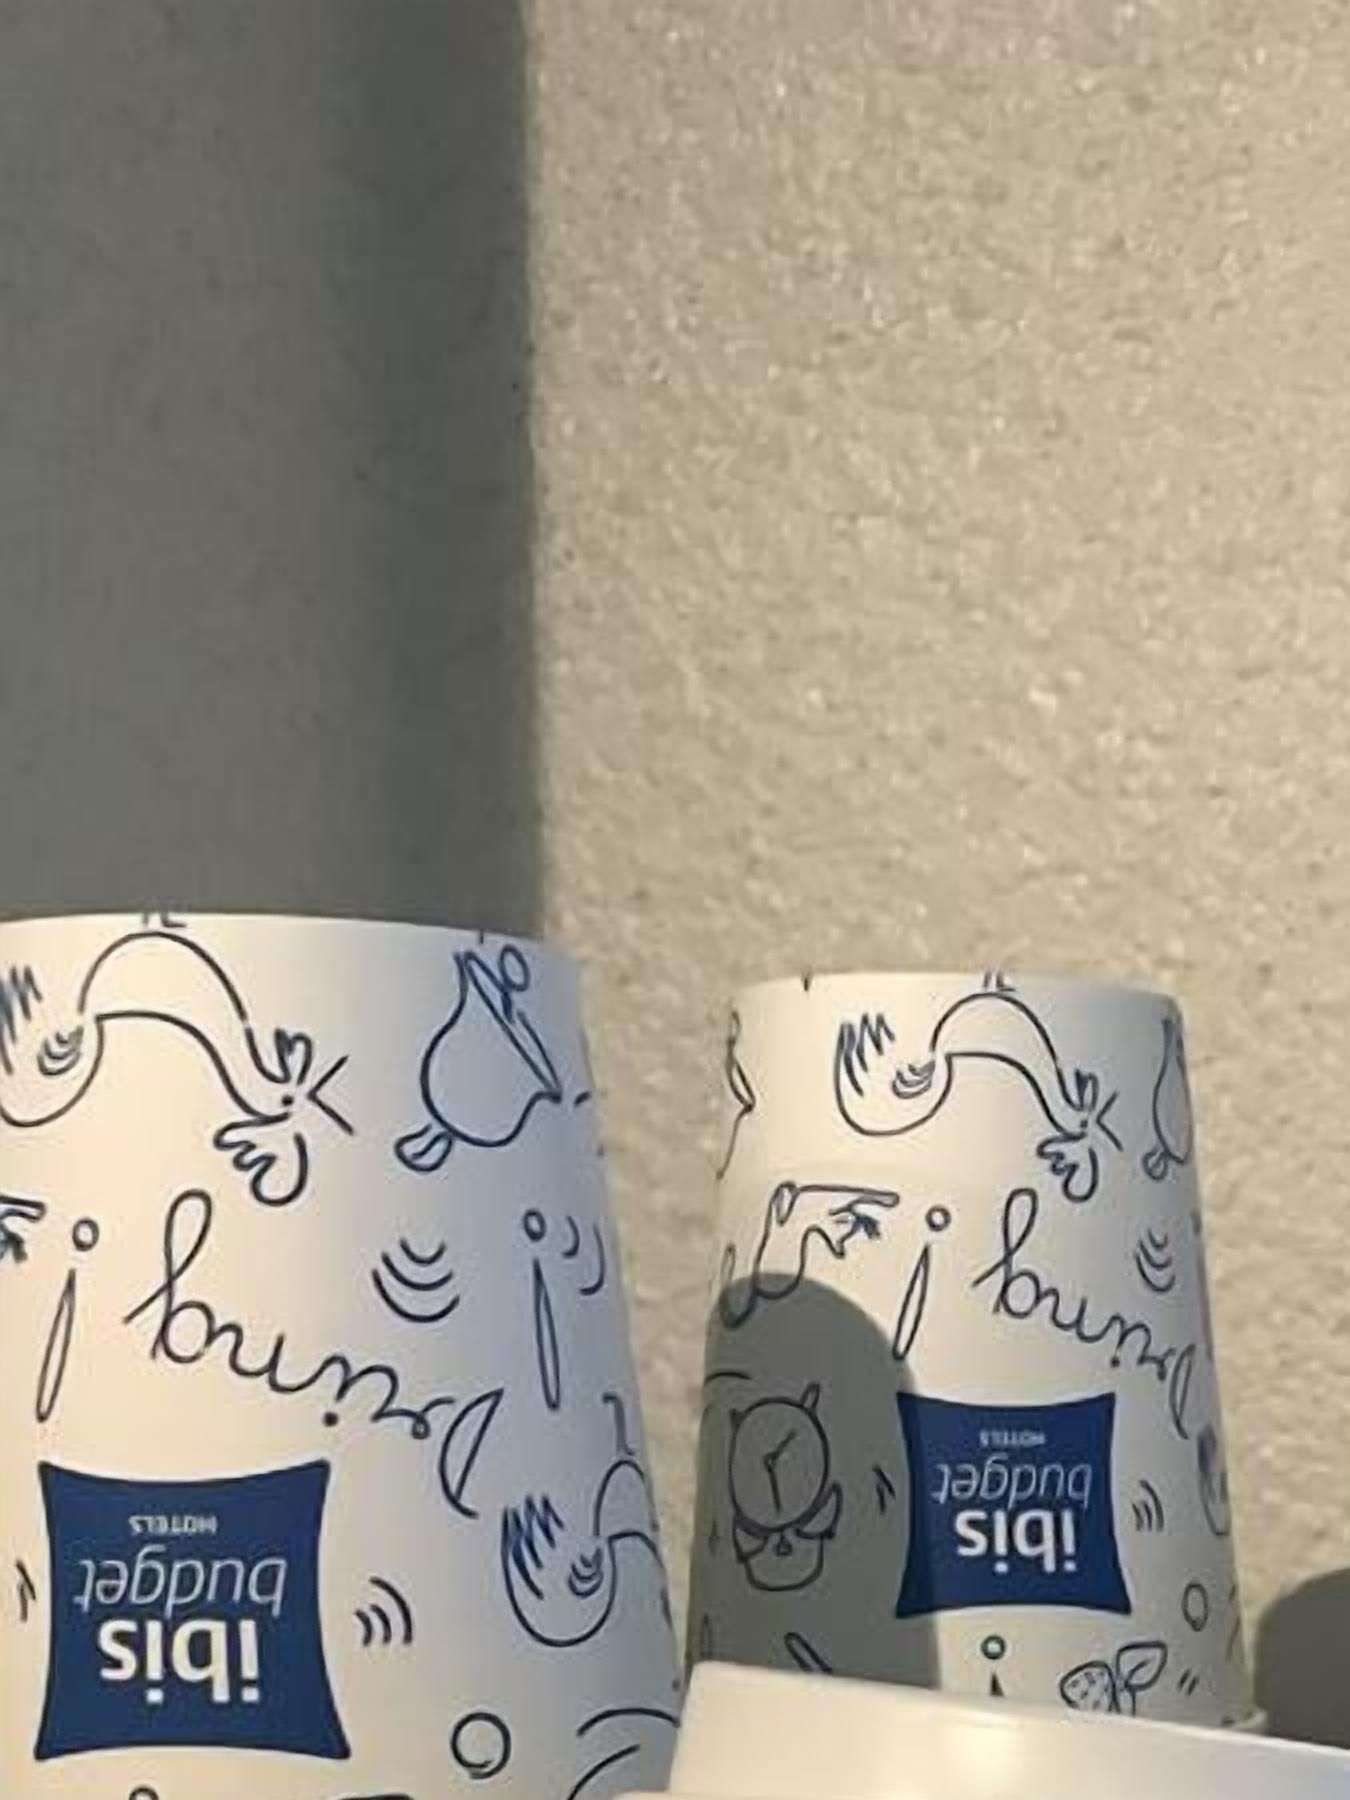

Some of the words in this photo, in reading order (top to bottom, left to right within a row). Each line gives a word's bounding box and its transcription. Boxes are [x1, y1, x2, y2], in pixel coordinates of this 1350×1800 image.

[971, 1187, 1196, 1440] Dring
[124, 1188, 504, 1519] Dring
[930, 1452, 1093, 1511] budget
[129, 1513, 219, 1536] HOTELS
[953, 1507, 1077, 1573] ibis
[74, 1543, 288, 1618] budget
[99, 1618, 261, 1704] ibis
